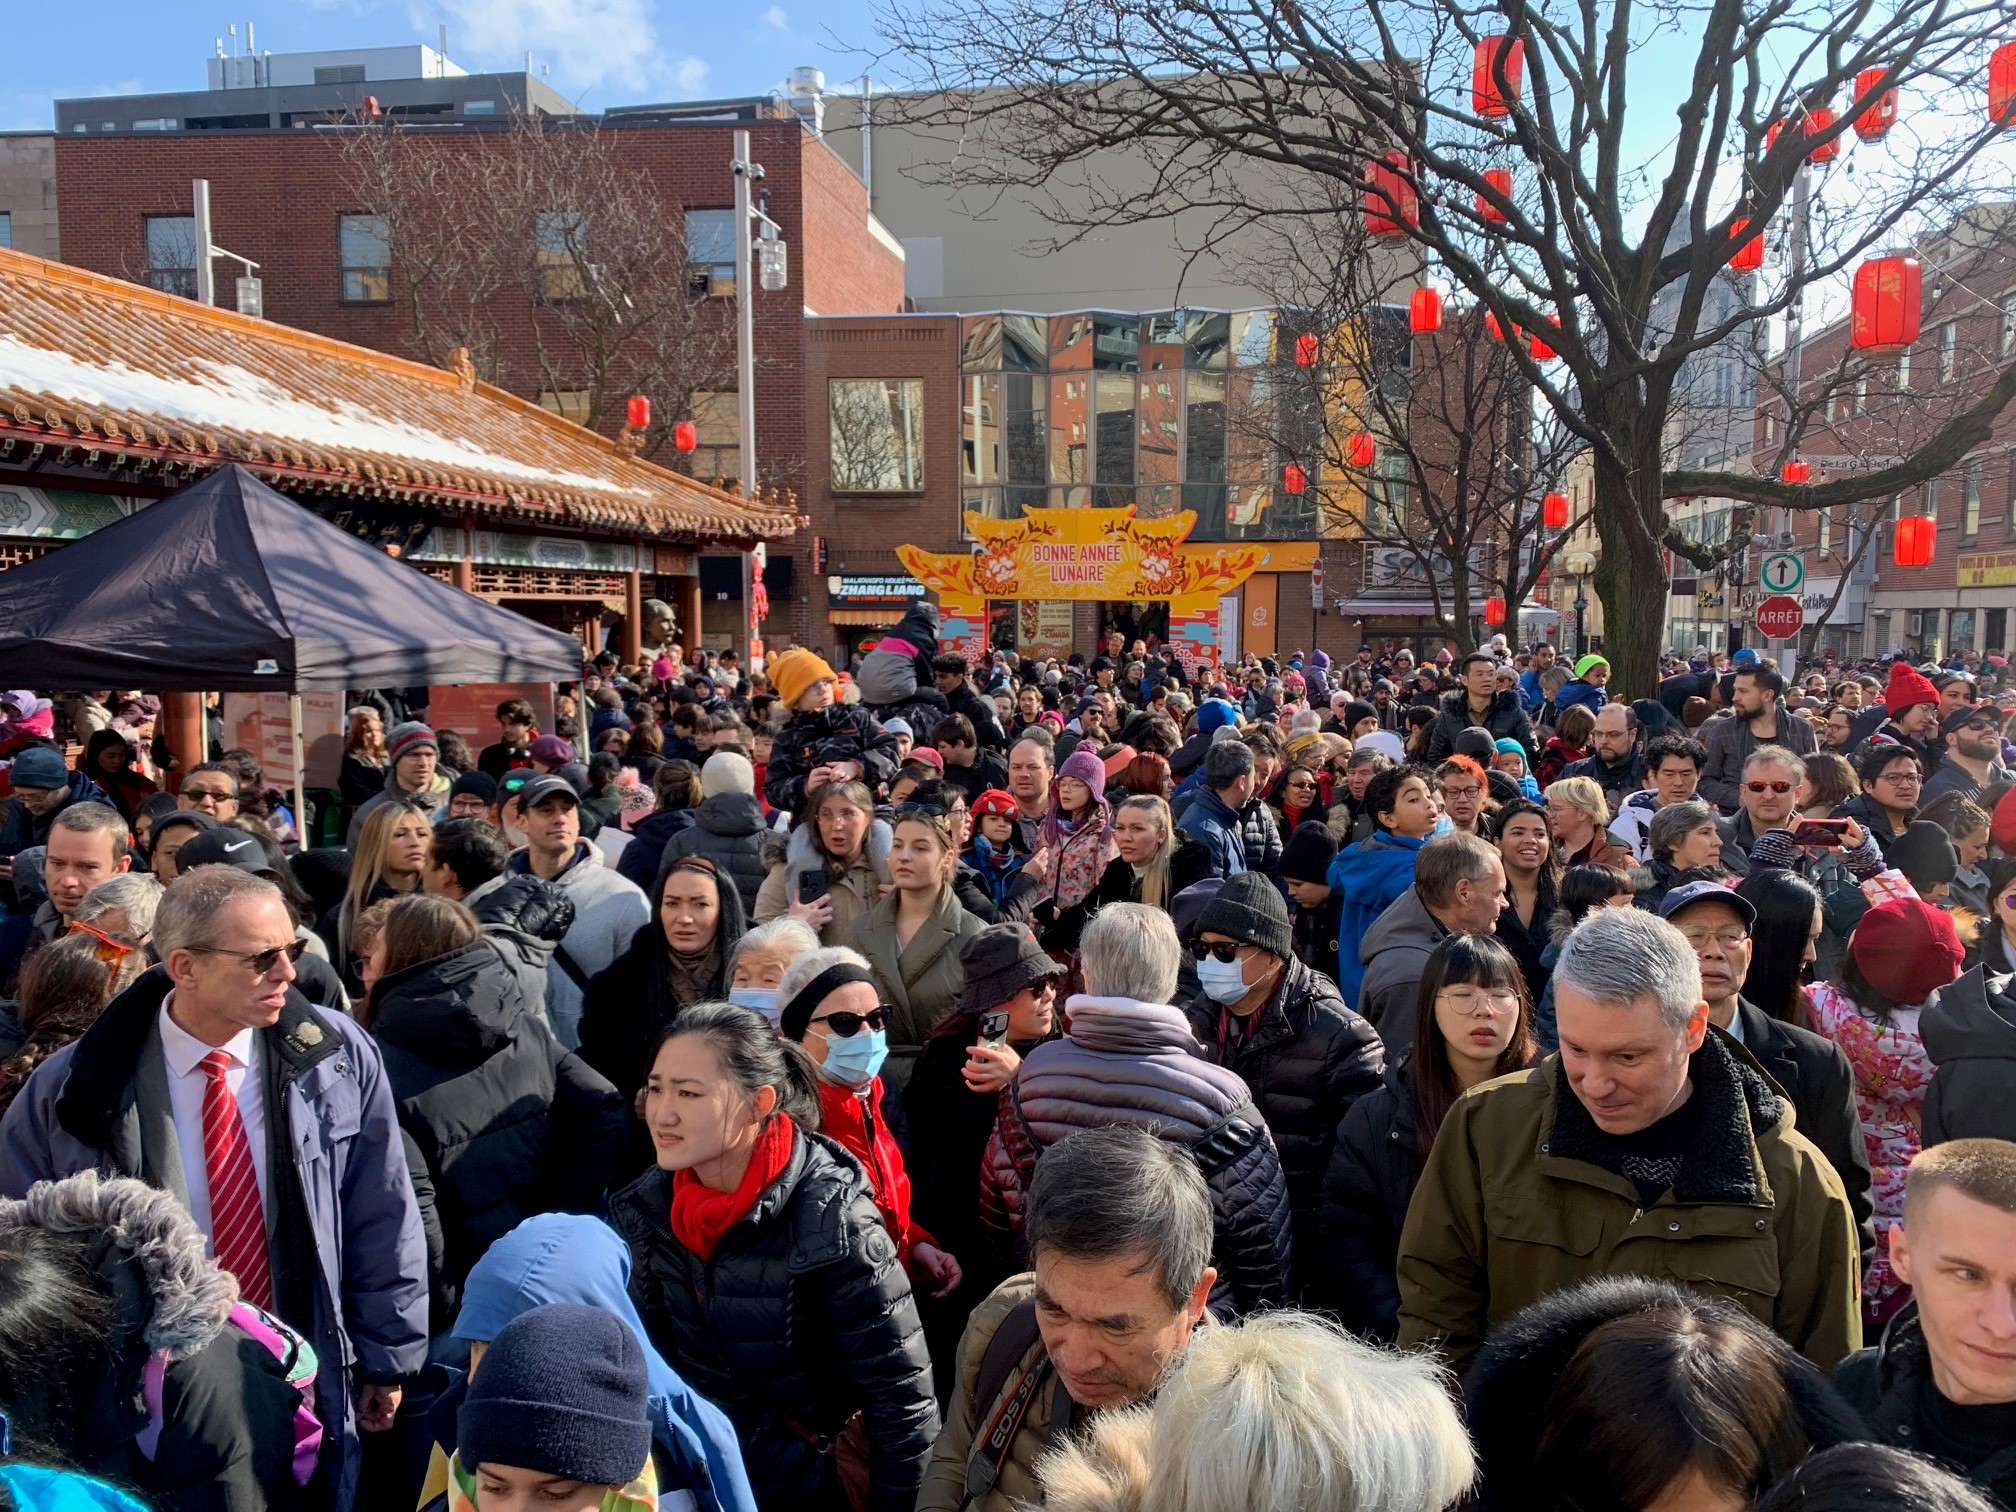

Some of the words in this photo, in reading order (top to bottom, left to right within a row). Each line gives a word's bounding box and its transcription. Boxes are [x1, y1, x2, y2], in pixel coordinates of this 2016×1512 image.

[1033, 544, 1077, 562] BONNE
[1080, 542, 1121, 562] ANNÉE
[1051, 564, 1105, 583] LUNAIRE
[840, 585, 885, 596] ZHANG
[885, 585, 925, 596] LIANG
[1759, 609, 1801, 624] ARRÊT
[285, 1034, 307, 1053] KANUK
[991, 1400, 1020, 1449] EOS
[1019, 1373, 1034, 1398] 5D
